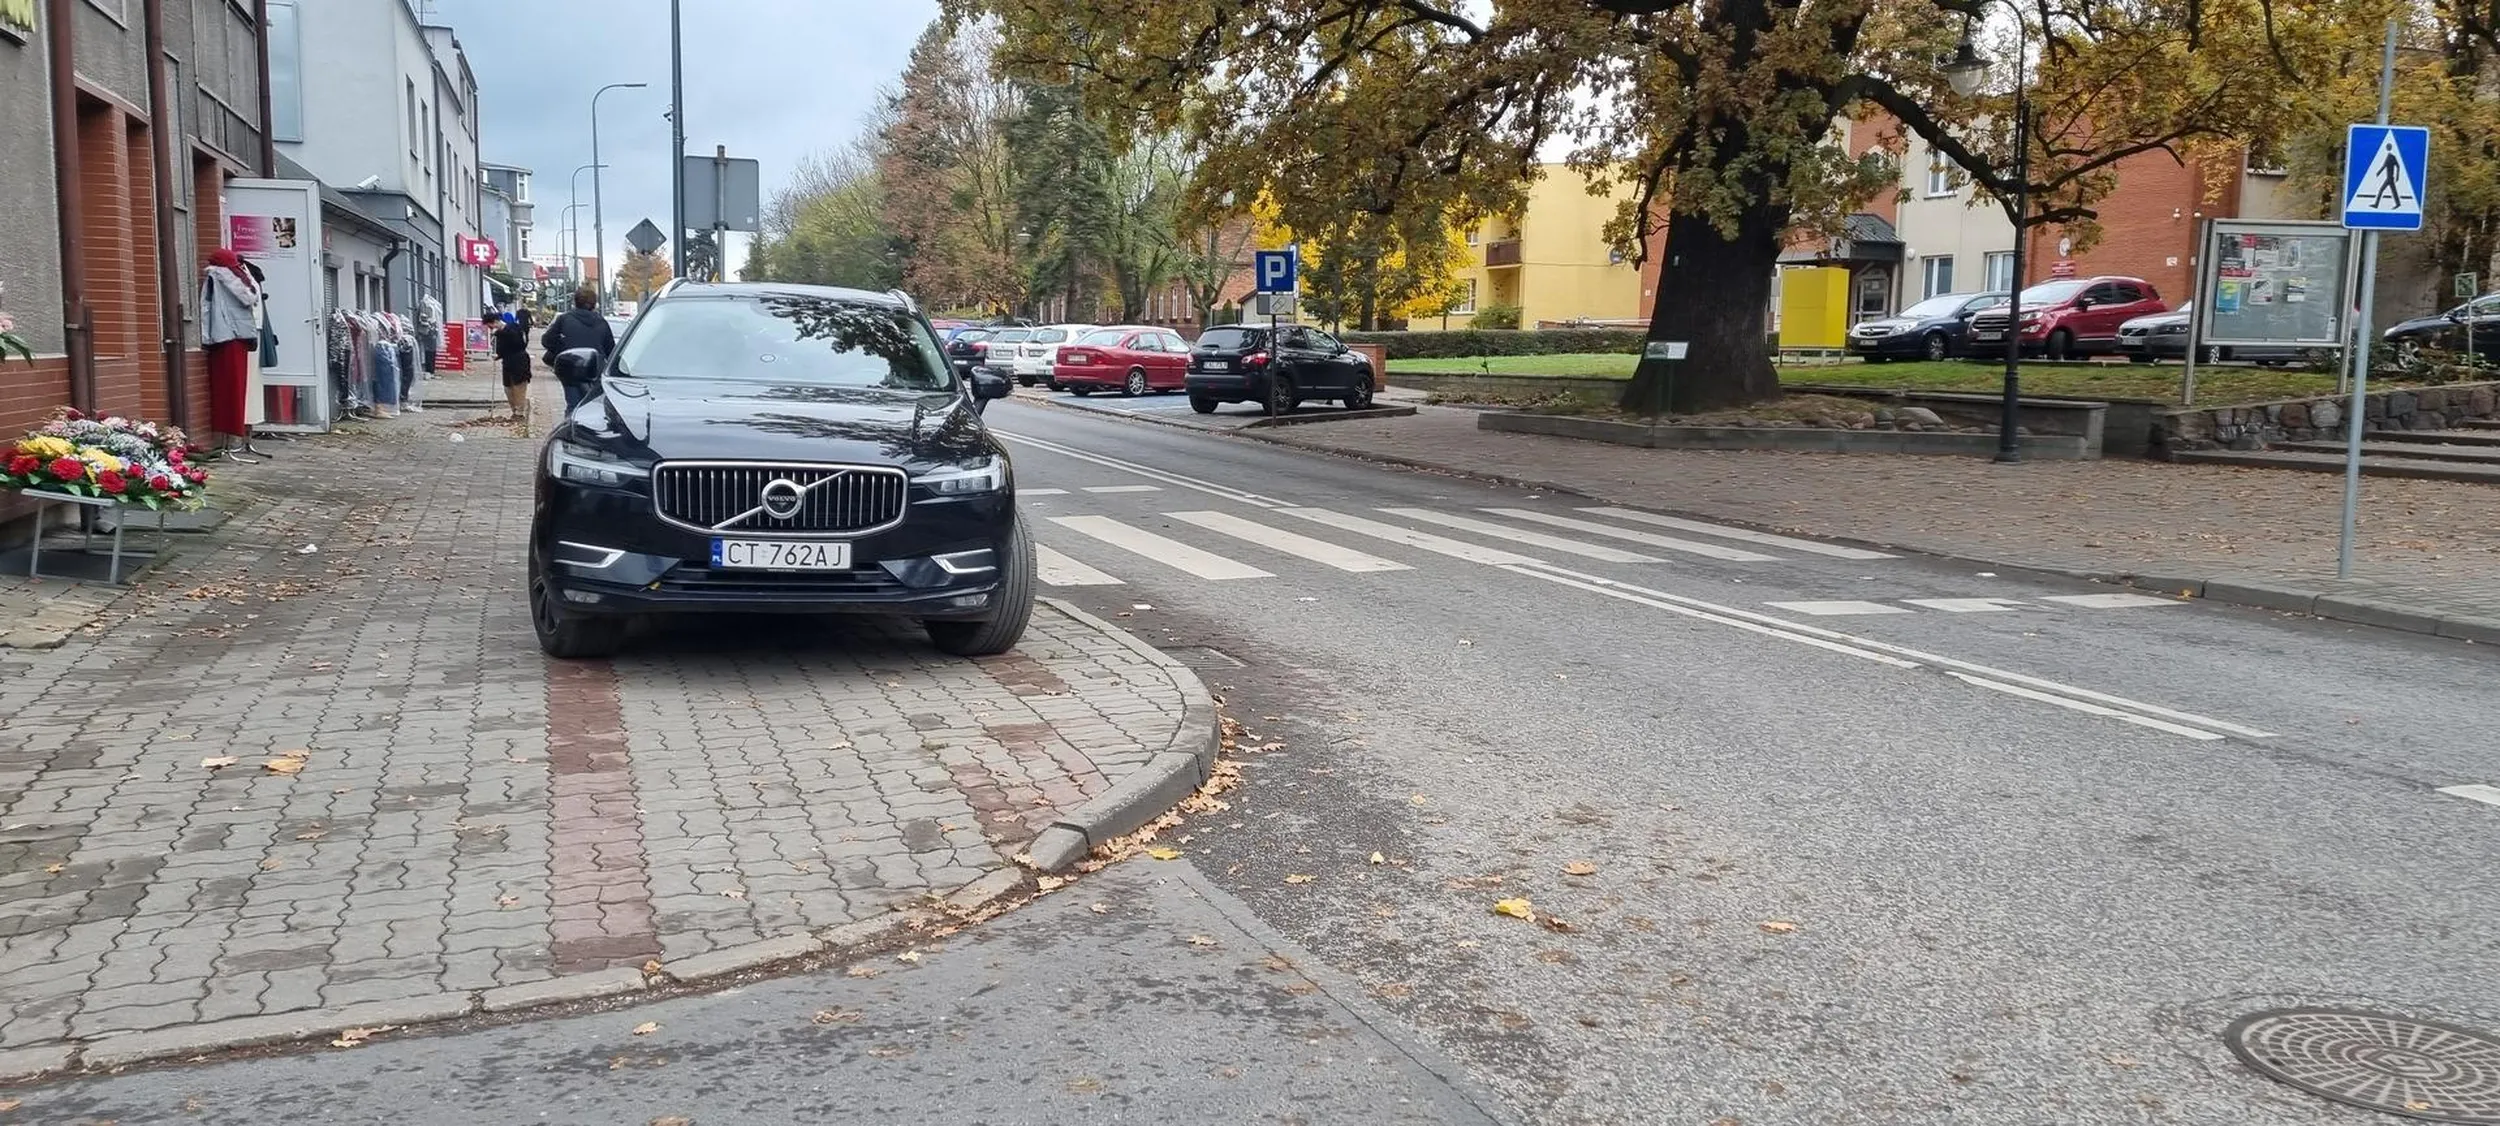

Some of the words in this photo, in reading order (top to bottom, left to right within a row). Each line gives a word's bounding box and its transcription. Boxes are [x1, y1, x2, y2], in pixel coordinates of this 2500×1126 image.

[473, 243, 490, 262] T
[1265, 255, 1286, 287] P
[728, 542, 759, 565] CT
[769, 544, 842, 567] 762AJ
